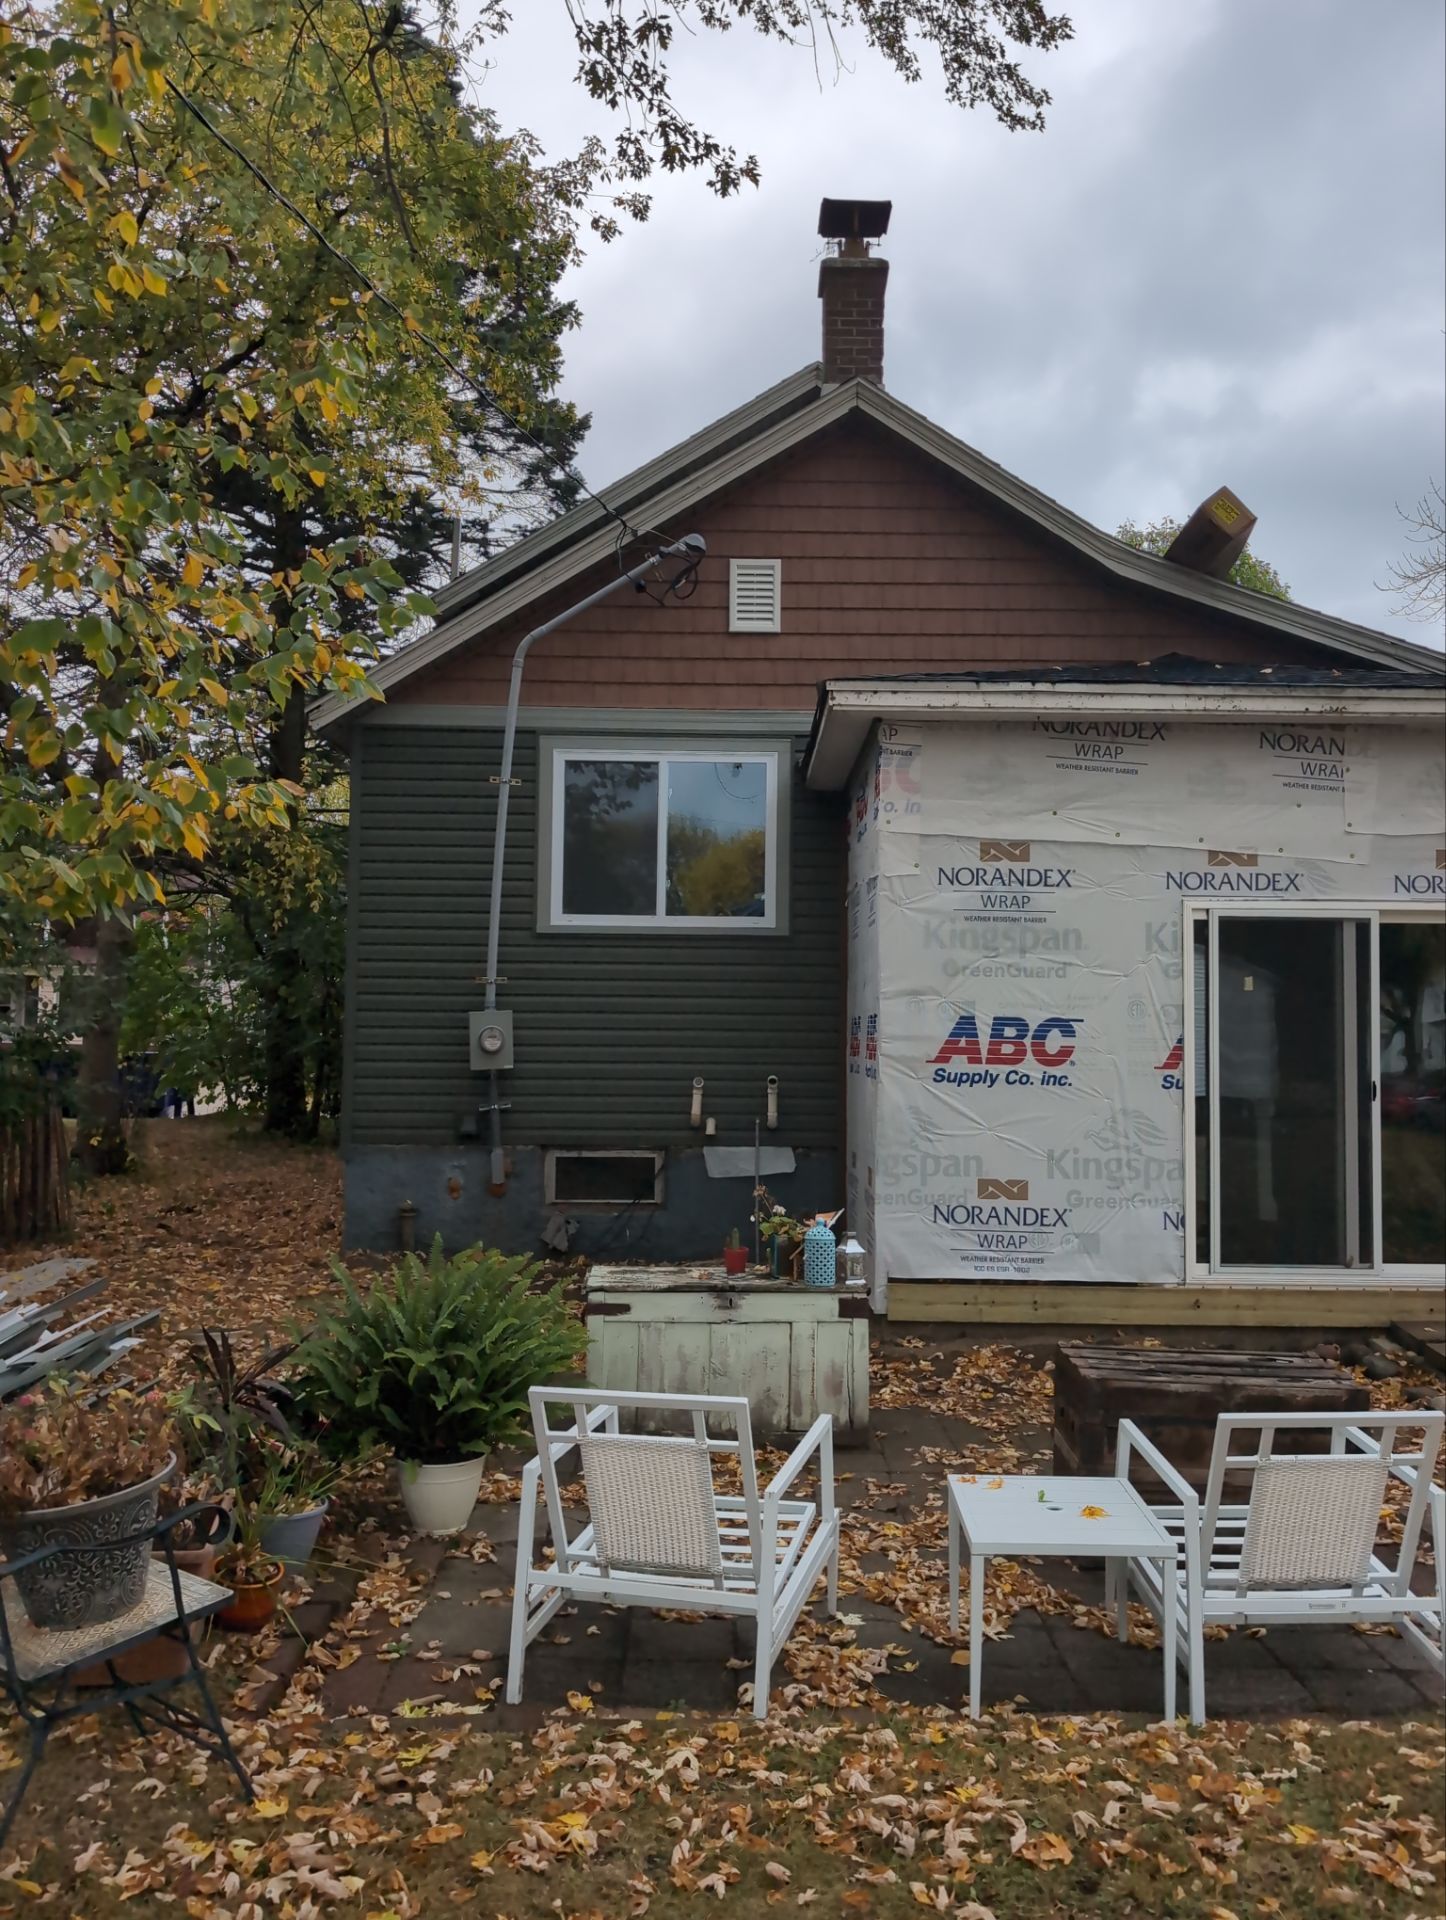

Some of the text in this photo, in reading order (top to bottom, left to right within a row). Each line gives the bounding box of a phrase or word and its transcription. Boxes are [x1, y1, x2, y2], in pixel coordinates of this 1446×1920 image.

[1074, 743, 1124, 760] WRAP
[1055, 762, 1139, 776] WEATHER RESISTANT BARRIER
[1282, 781, 1310, 790] WEATHER
[1310, 783, 1341, 793] RESISTANT
[937, 866, 1073, 888] NORANDEX
[1165, 871, 1301, 892] NORANDEX
[1394, 873, 1446, 894] NOR
[980, 894, 1031, 909] WRAP
[963, 914, 1047, 924] WEATHER RESISTANT BARRIER
[923, 919, 1083, 958] Kingspan
[942, 957, 1067, 979] GreenGuard
[926, 1015, 1084, 1067] ABC
[932, 1068, 1073, 1088] Supply Co. inc.
[932, 1204, 1069, 1228] NORANDEX
[977, 1233, 1028, 1249] WRAP
[960, 1255, 1045, 1265] WEATHER RESISTANT BARRIER
